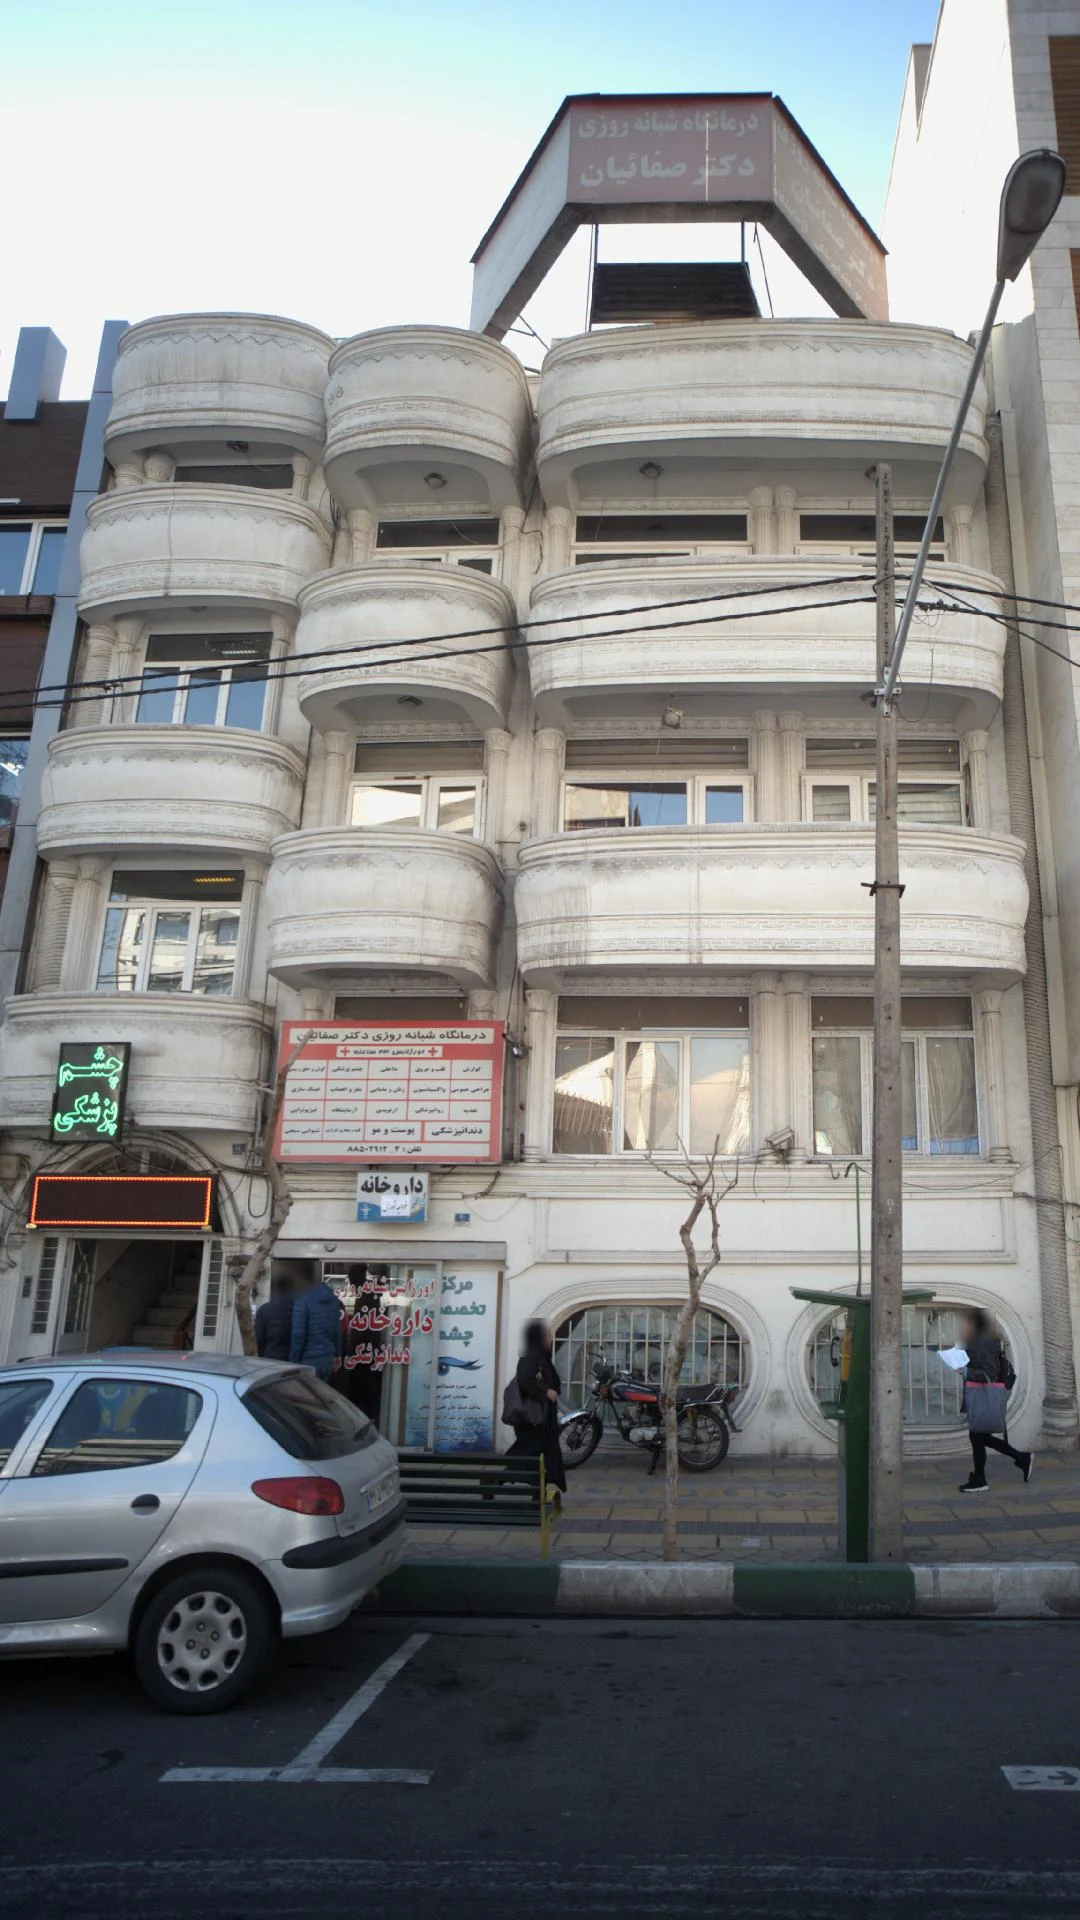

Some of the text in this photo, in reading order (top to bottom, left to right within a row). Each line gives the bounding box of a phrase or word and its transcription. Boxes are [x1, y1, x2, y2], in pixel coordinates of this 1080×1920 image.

[578, 109, 758, 139] درمانگاه شبانه روزی
[580, 150, 756, 187] دکتر صفائیان
[342, 1031, 369, 1042] دکتر
[372, 1031, 402, 1042] روزی
[405, 1030, 436, 1041] شبانه
[439, 1030, 486, 1041] درمانگاه
[59, 1046, 124, 1090] چشم
[54, 1091, 118, 1136] پزشکی
[390, 1126, 415, 1135] پوست
[431, 1126, 483, 1136] دندانپزشکی
[360, 1175, 424, 1195] داروخانه
[362, 1275, 389, 1300] شبانه
[441, 1275, 473, 1295] مرکز
[349, 1305, 434, 1337] داروخانه
[344, 1341, 411, 1372] دندانپزشکی
